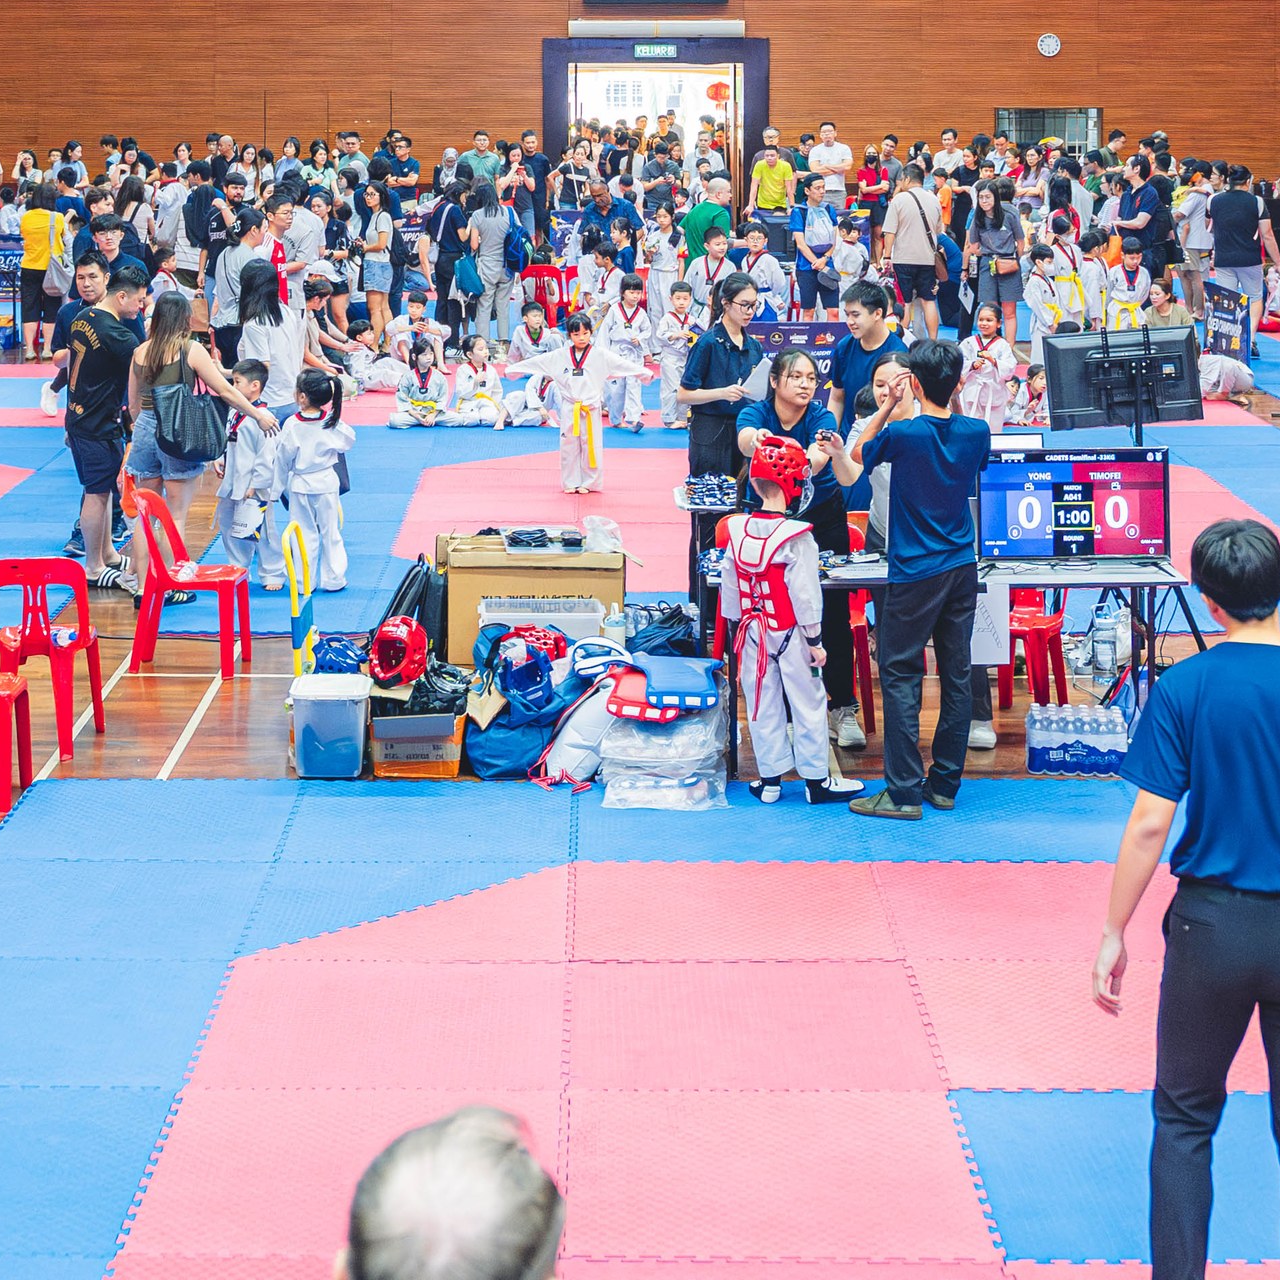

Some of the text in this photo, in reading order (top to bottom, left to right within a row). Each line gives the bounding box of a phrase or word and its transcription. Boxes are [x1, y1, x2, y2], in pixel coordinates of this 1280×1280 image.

[637, 46, 667, 56] KELUAR
[69, 340, 86, 392] 7
[1028, 472, 1052, 480] YONG
[1089, 472, 1121, 480] TIMOFEI
[1018, 496, 1042, 529] 0
[1057, 510, 1090, 524] 1:00
[1105, 495, 1129, 529] 0
[993, 548, 999, 556] 0
[1070, 544, 1077, 553] 1
